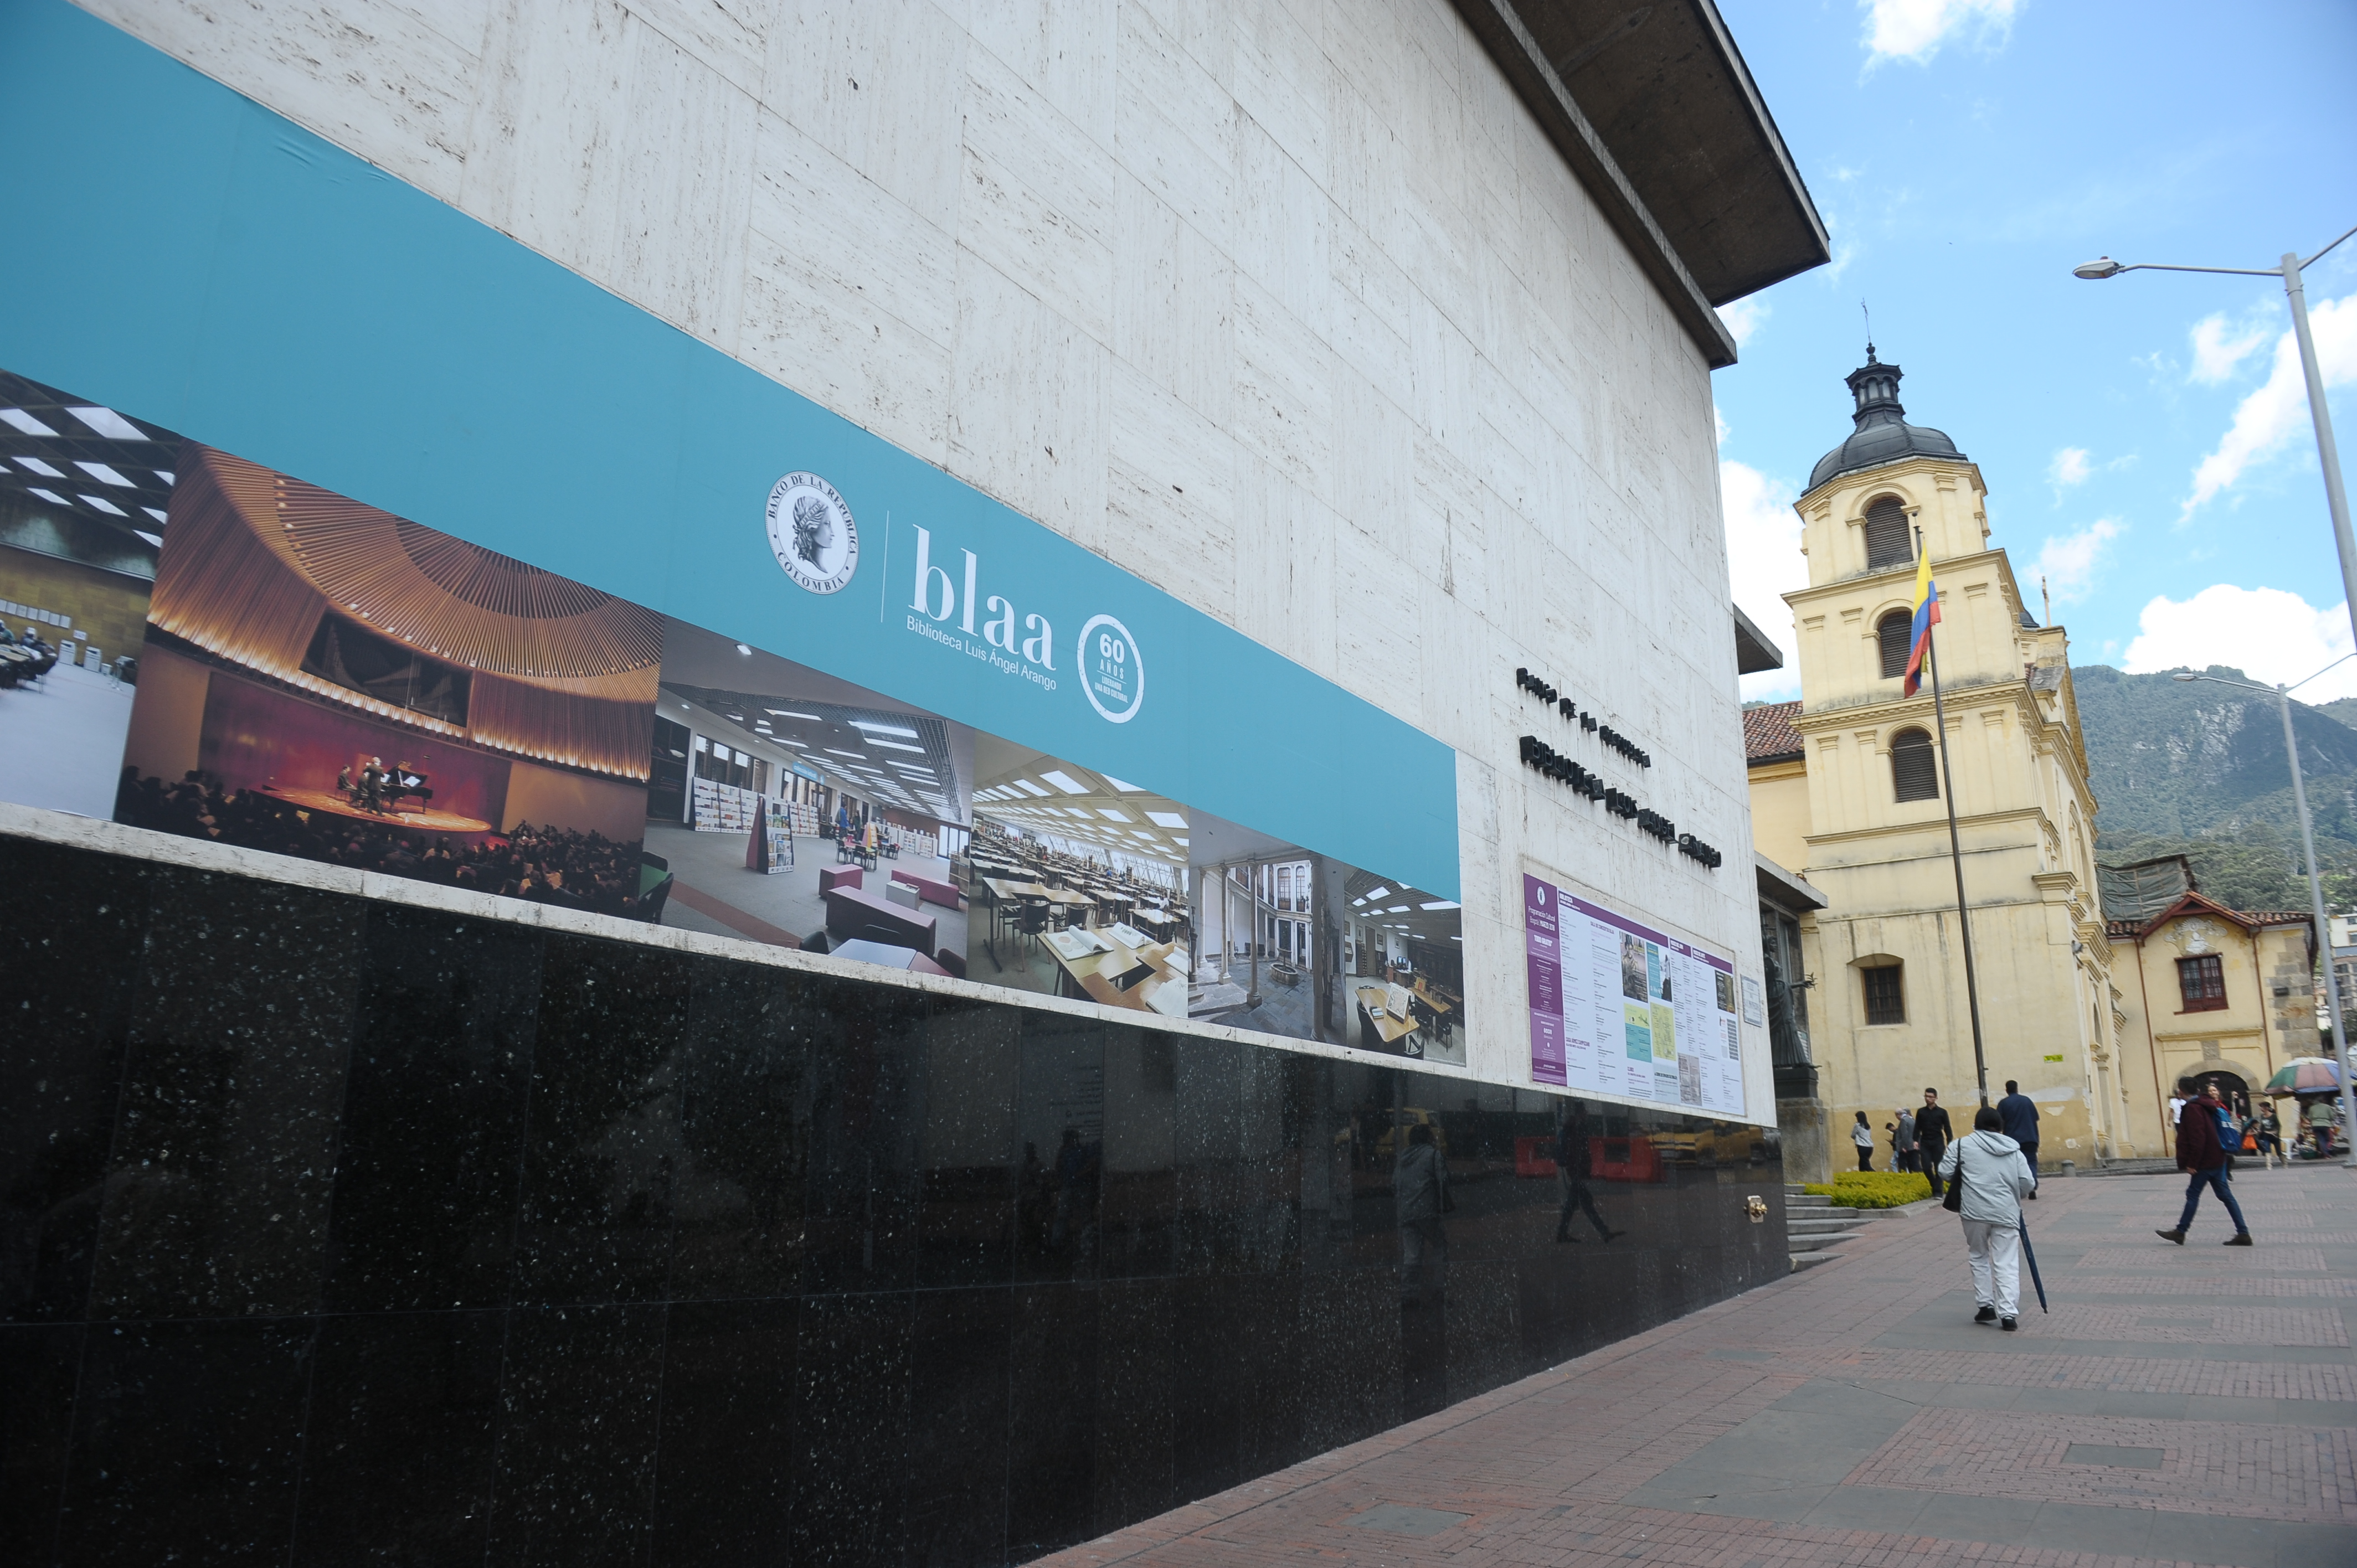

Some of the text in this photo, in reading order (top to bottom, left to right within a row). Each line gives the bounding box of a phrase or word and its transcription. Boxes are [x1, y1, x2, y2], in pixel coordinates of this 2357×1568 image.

[768, 481, 788, 519] BANCO
[790, 474, 805, 485] DE
[810, 476, 824, 490] LA
[778, 552, 844, 591] COLOMBIA
[908, 524, 1056, 670] blaa
[907, 615, 1057, 691] Biblioteca Luis Ángel Arango
[1099, 633, 1125, 663] 60
[1100, 659, 1124, 679] AÑOS
[1102, 675, 1122, 691] LIDERANDO
[1094, 682, 1103, 692] UNA
[1111, 689, 1129, 703] CULTURAL
